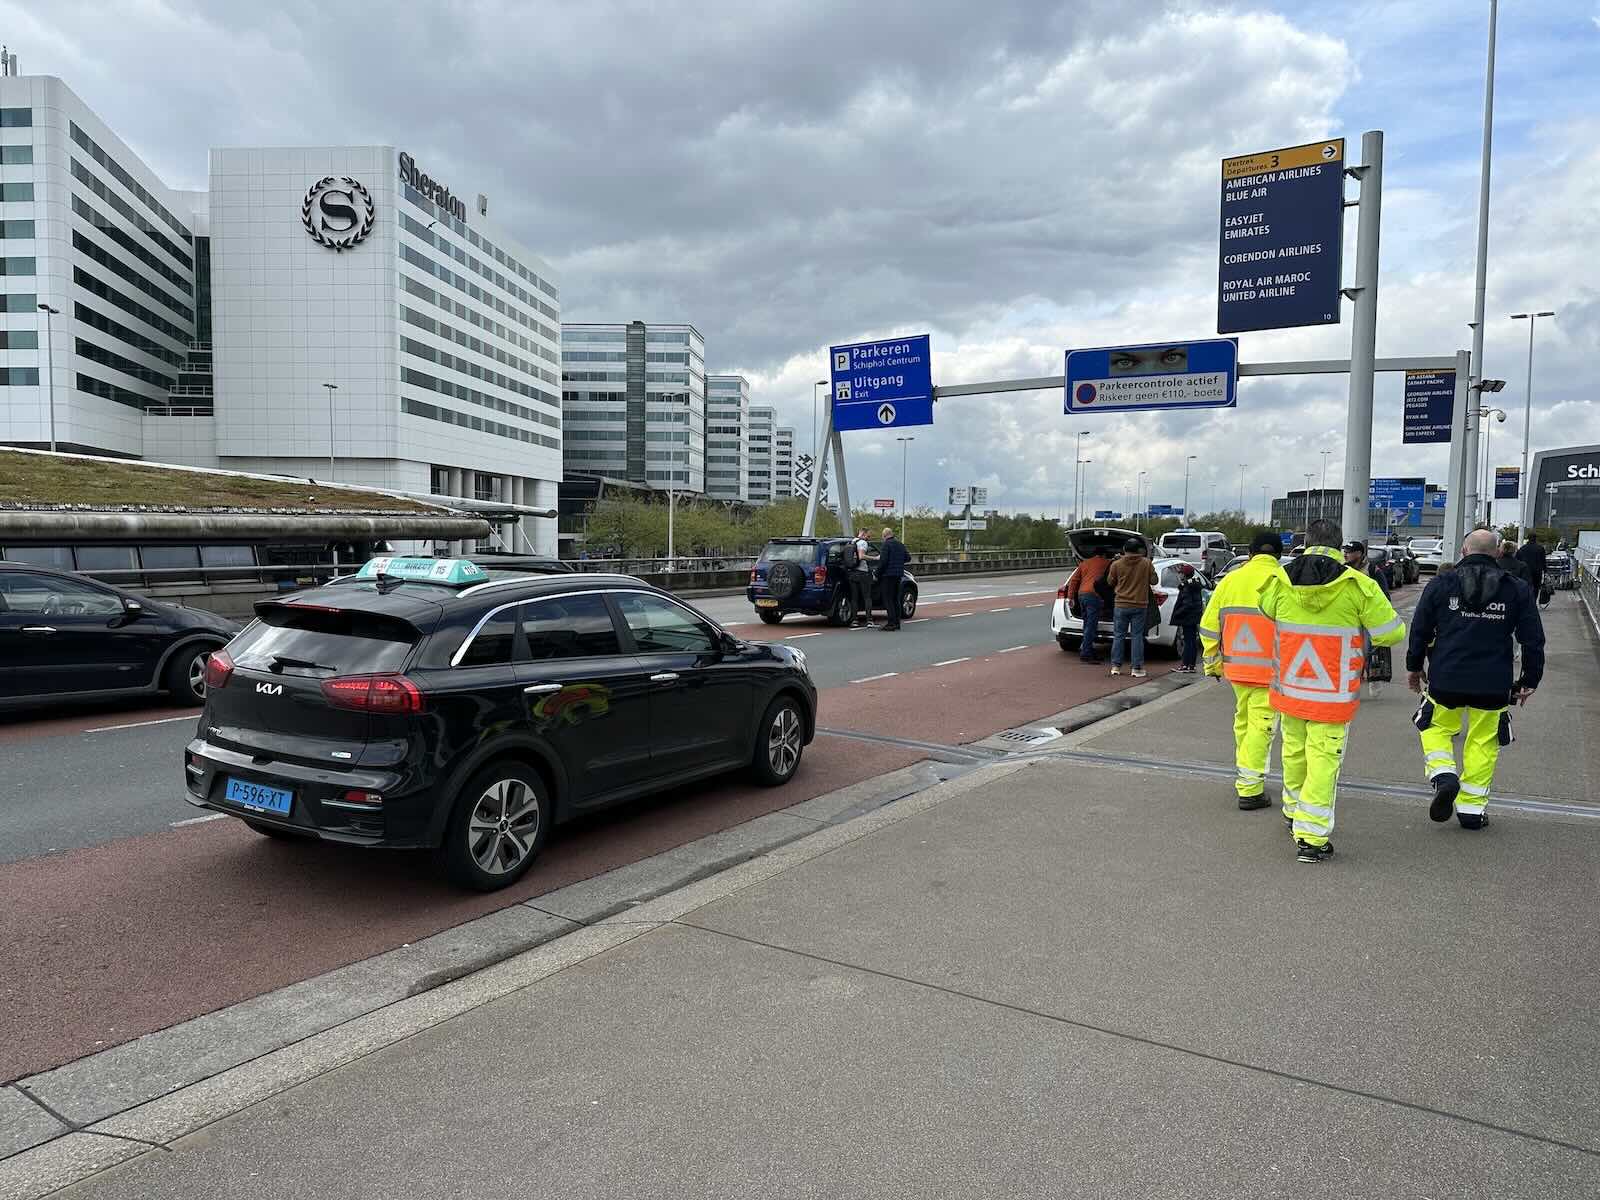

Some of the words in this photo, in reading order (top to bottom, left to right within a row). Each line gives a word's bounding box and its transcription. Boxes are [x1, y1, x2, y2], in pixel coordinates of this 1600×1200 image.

[1270, 155, 1280, 168] 3
[1226, 172, 1276, 189] AMERICAN
[1278, 165, 1322, 181] AIRLINES
[1227, 163, 1268, 176] Departures
[399, 151, 467, 223] Sheraton
[1225, 190, 1249, 202] BLUE
[1251, 187, 1268, 199] AIR
[1225, 212, 1264, 227] EASYJET
[1224, 225, 1270, 240] EMIRATES
[1224, 250, 1276, 265] CORENDON
[1278, 243, 1322, 258] AIRLINES
[1223, 276, 1254, 290] ROYAL
[1256, 273, 1273, 286] AIR
[1275, 271, 1311, 284] MAROC
[1223, 289, 1256, 302] UNITED
[1258, 285, 1296, 299] AIRLINE
[853, 344, 910, 359] Parkeren
[853, 359, 886, 370] Schiphol
[887, 355, 921, 366] Centrum
[854, 375, 904, 389] Uitgang
[1100, 377, 1183, 391] Parkeercontrole
[1186, 375, 1219, 387] actief
[855, 390, 870, 399] Exit
[1099, 391, 1132, 402] Riskeer
[1135, 391, 1159, 402] geen
[1193, 387, 1223, 397] boete
[1567, 463, 1600, 478] Sch
[463, 565, 477, 576] 115
[1481, 611, 1505, 620] Support
[256, 682, 283, 695] KIA
[232, 782, 285, 808] P-596-XT
